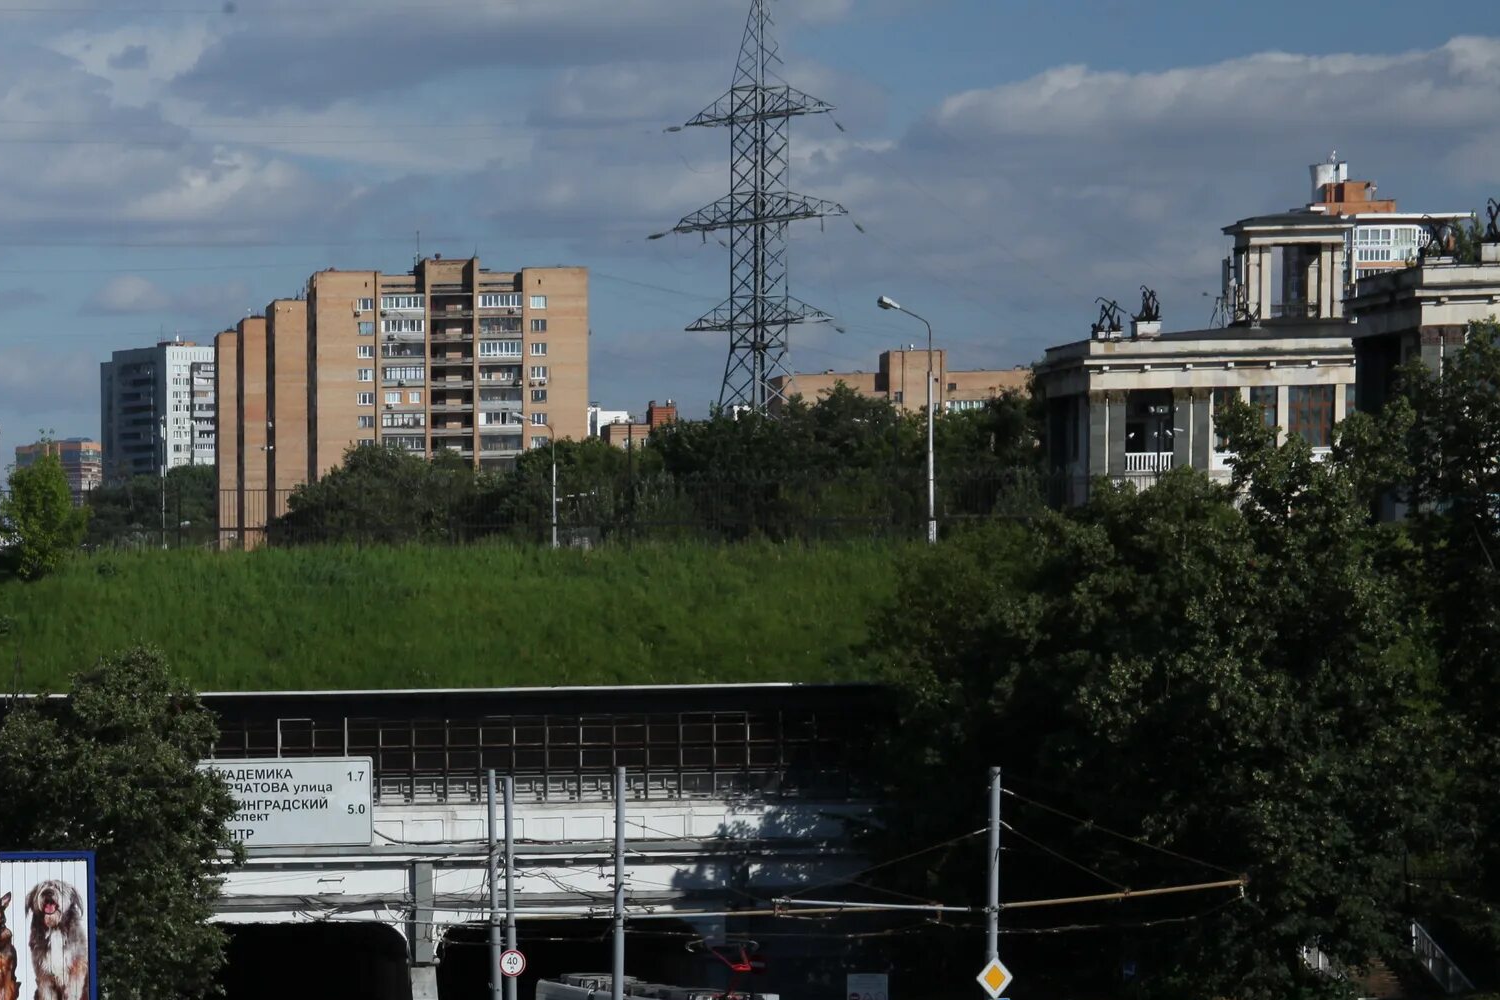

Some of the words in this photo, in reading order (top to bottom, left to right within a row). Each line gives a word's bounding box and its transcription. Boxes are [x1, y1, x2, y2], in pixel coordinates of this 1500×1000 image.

[347, 771, 364, 781] 1.7
[227, 782, 289, 793] РЧАТОВА
[293, 783, 333, 795] улица
[347, 804, 365, 815] 5.0
[226, 813, 269, 822] оспект
[229, 829, 254, 839] НТР
[507, 957, 518, 965] 40
